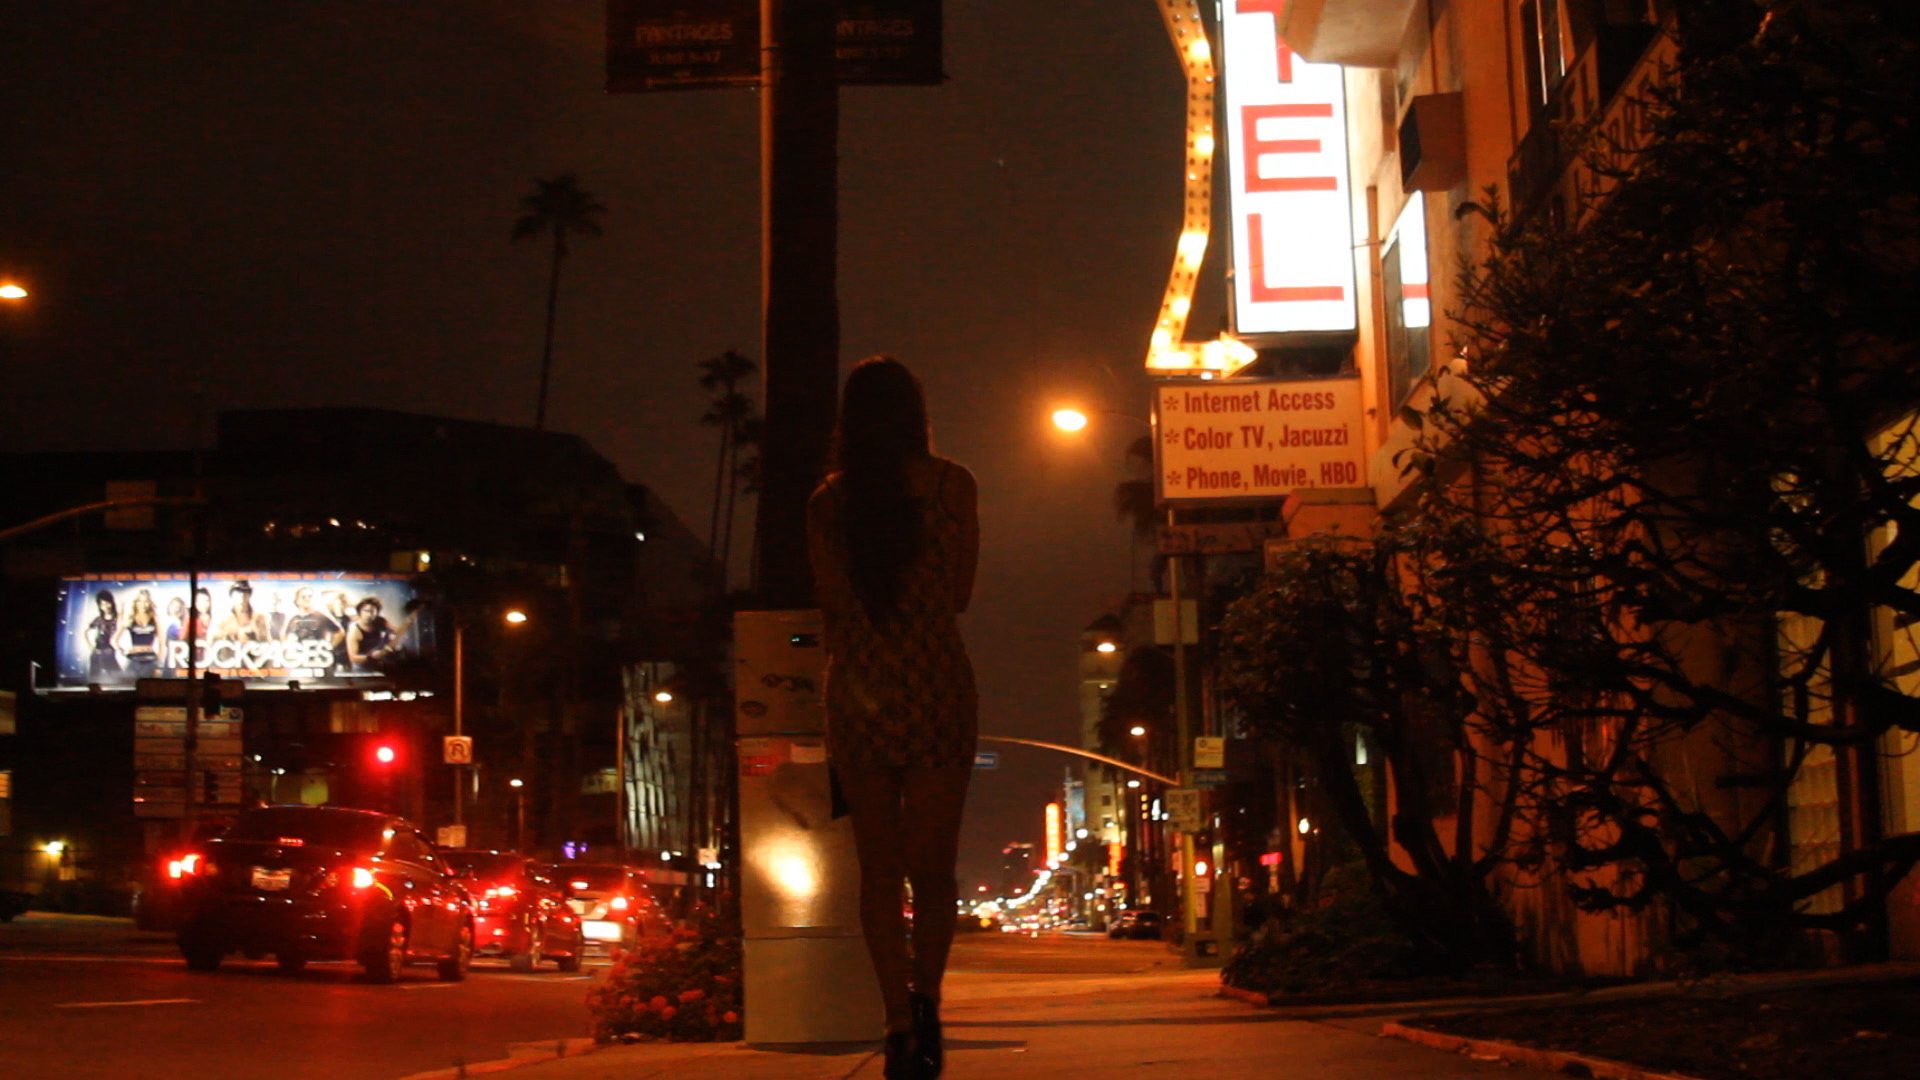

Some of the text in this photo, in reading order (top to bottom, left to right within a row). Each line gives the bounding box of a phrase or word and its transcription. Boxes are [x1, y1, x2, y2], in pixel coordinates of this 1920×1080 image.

[1184, 388, 1335, 413] Internet Access
[1183, 427, 1233, 450] Color
[1279, 423, 1349, 448] Jacuzzi
[1186, 461, 1358, 491] Phone, Movie, HBO
